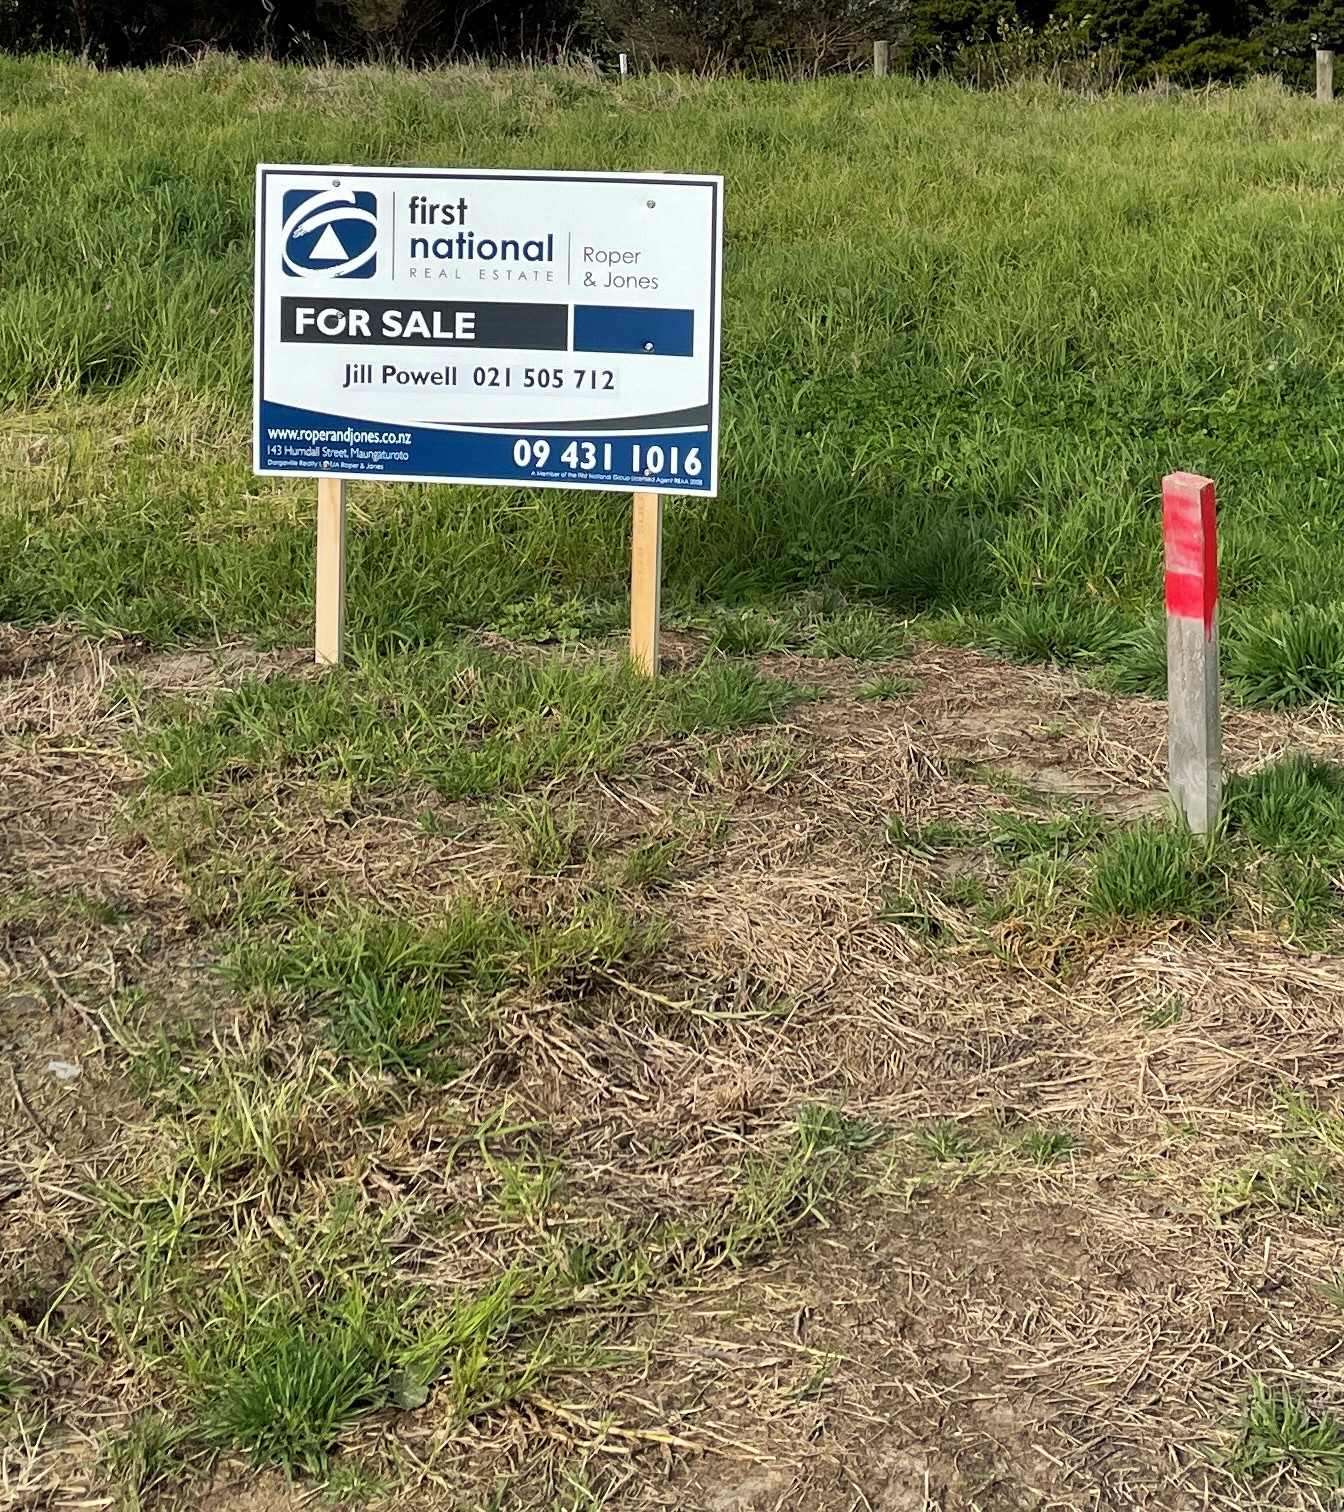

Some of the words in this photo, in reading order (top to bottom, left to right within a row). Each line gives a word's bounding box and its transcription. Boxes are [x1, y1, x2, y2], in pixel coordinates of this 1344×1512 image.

[408, 195, 468, 226] first
[409, 232, 554, 263] national
[583, 246, 641, 268] Roper
[409, 267, 462, 281] REAL
[479, 269, 556, 283] ESTATE
[583, 271, 597, 288] &
[603, 272, 659, 290] Jones
[294, 308, 370, 338] FOR
[382, 310, 476, 340] SALE
[343, 364, 372, 388] Jill
[382, 365, 457, 387] Powell
[473, 367, 512, 388] 021
[523, 369, 564, 389] 505
[574, 370, 615, 390] 712
[267, 426, 412, 446] www.roperandjones.co.nz
[267, 445, 282, 456] 143
[350, 448, 409, 462] Maungaturoto
[513, 438, 551, 468] 09
[560, 441, 612, 471] 431
[632, 444, 702, 476] 1016
